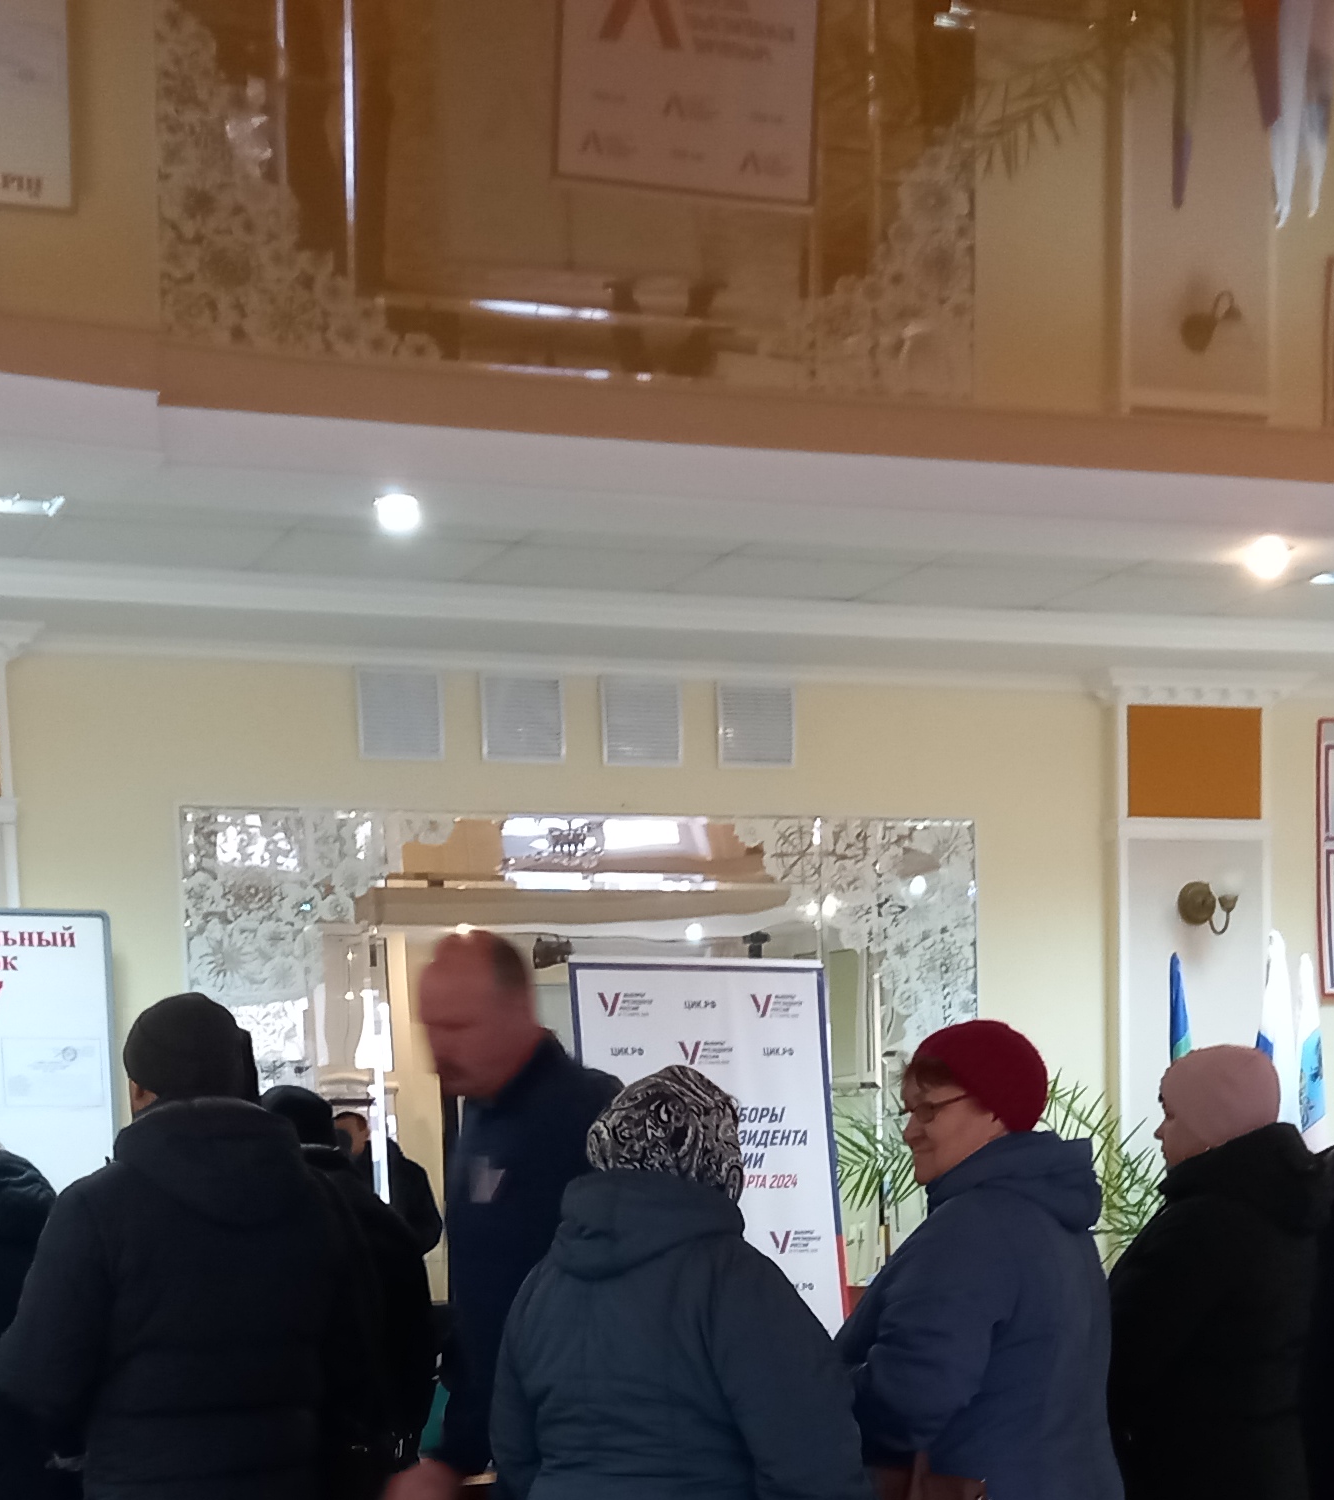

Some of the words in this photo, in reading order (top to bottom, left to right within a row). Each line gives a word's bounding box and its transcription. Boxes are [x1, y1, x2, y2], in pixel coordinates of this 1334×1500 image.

[739, 1106, 786, 1124] БОРЫ
[738, 1129, 809, 1149] ЗИДЕНТА
[769, 1174, 798, 1189] 2024
